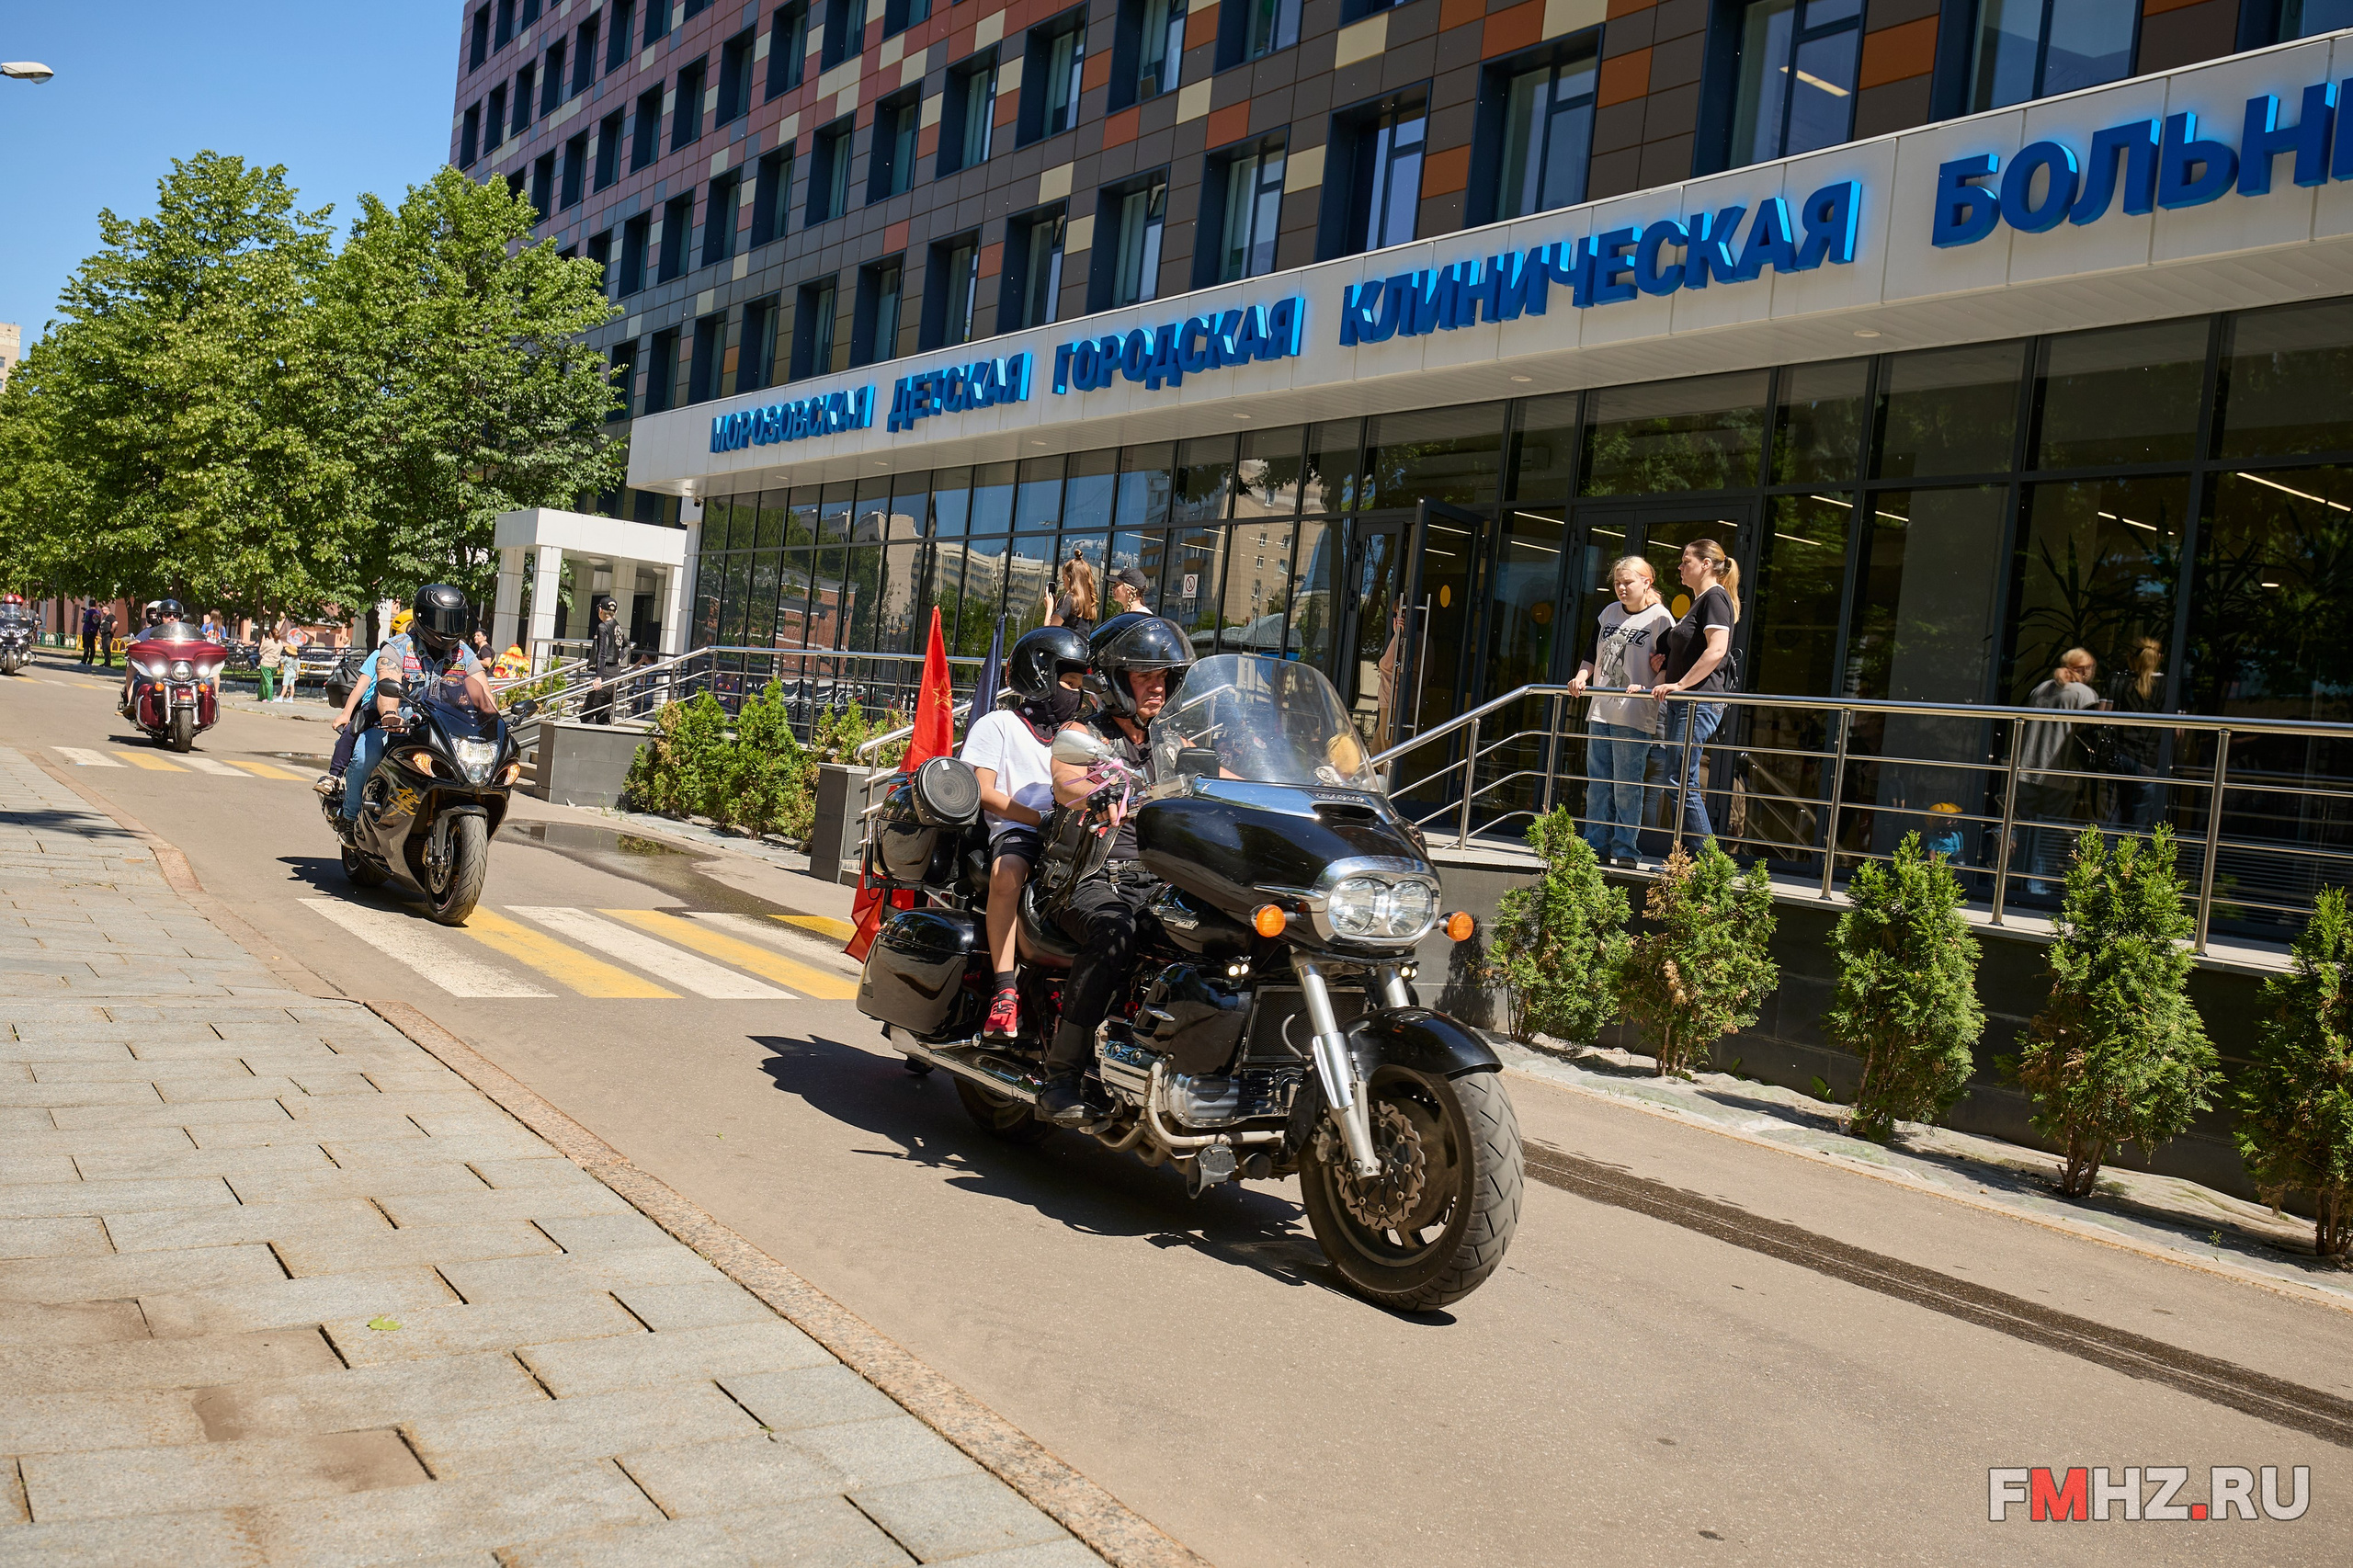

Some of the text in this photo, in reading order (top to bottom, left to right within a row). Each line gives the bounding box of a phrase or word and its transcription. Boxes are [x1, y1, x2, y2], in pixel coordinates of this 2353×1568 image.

[710, 77, 2353, 453] МОРОЗОВСКАЯ ДЕТСКАЯ ГОРОДСКАЯ КЛИНИЧЕСКАЯ БОЛЬН
